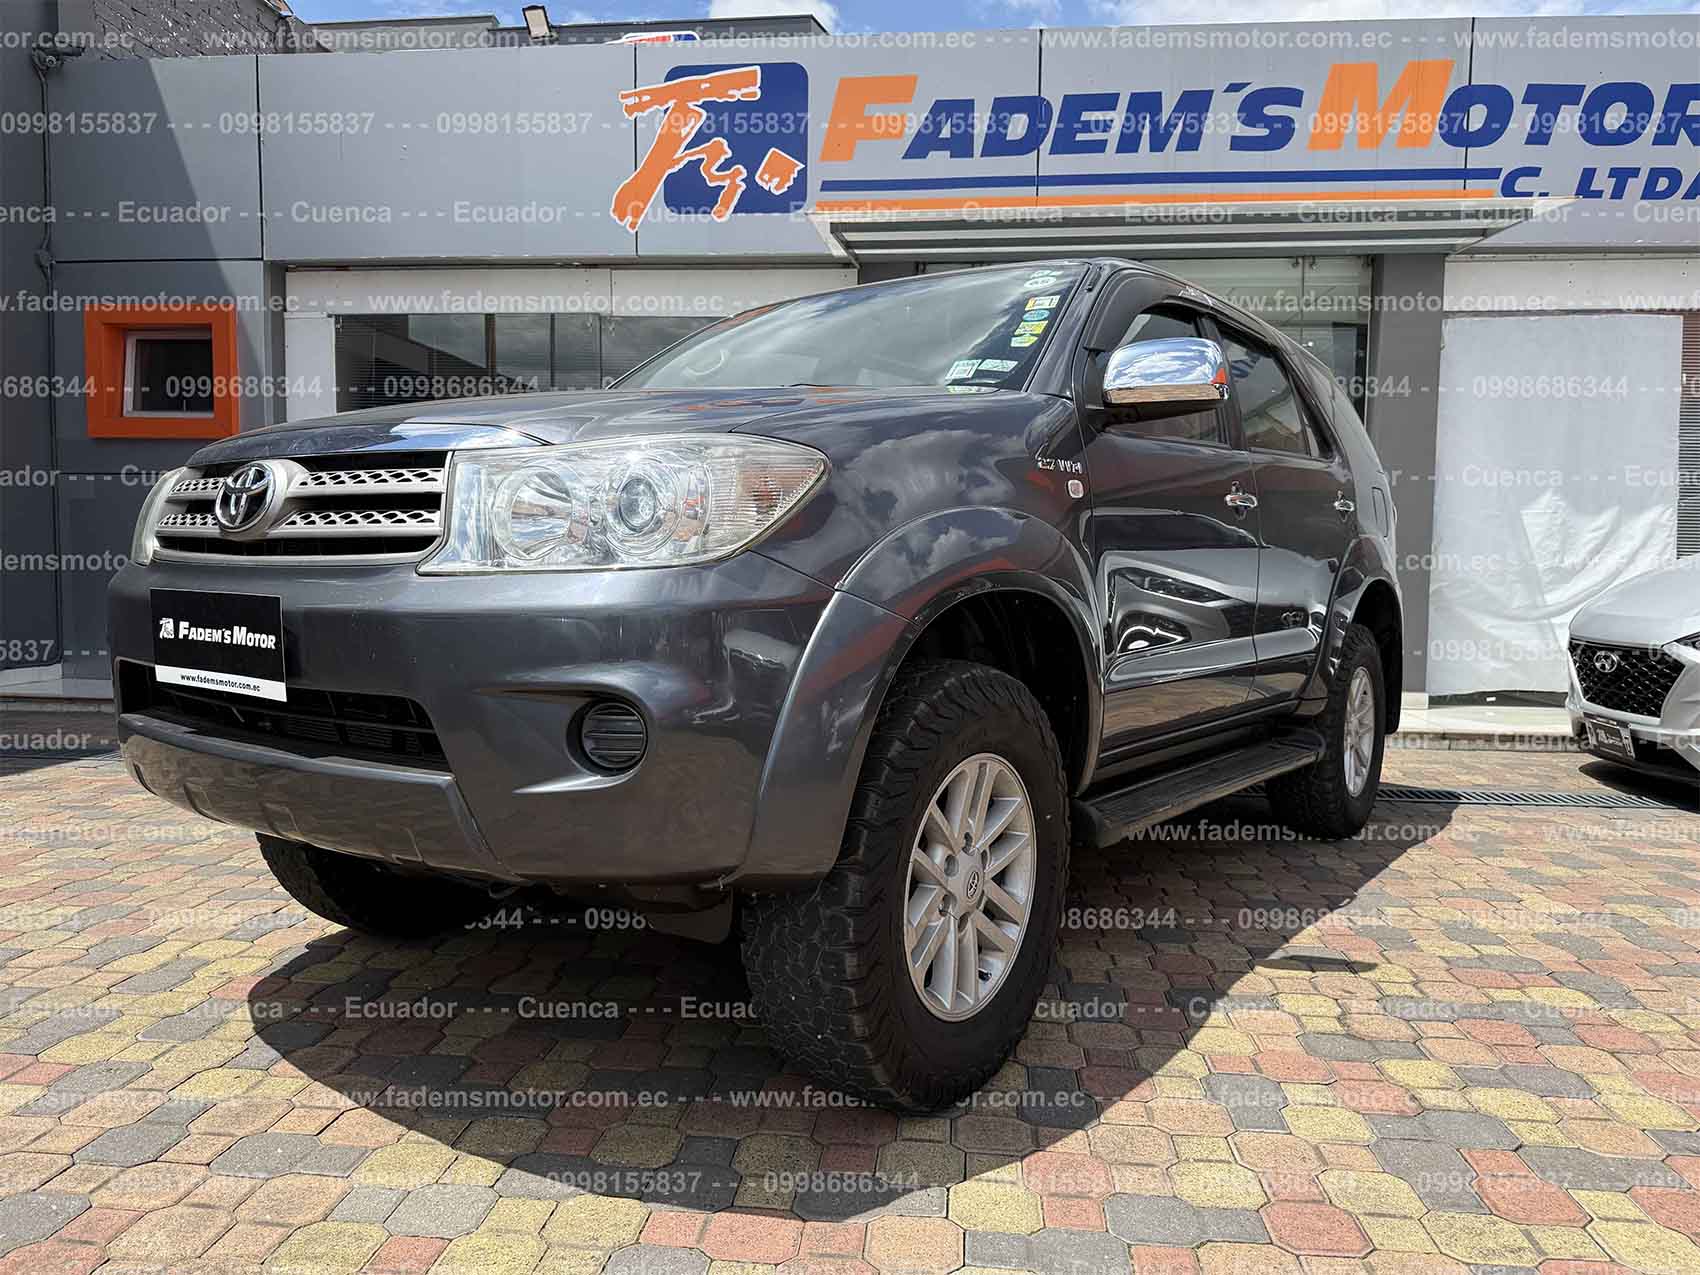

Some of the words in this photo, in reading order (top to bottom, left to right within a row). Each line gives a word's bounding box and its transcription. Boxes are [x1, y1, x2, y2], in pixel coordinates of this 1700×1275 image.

[1501, 166, 1549, 199] C.
[232, 625, 276, 649] MOTOR
[180, 673, 261, 693] www.fademsmotor.com.ec
